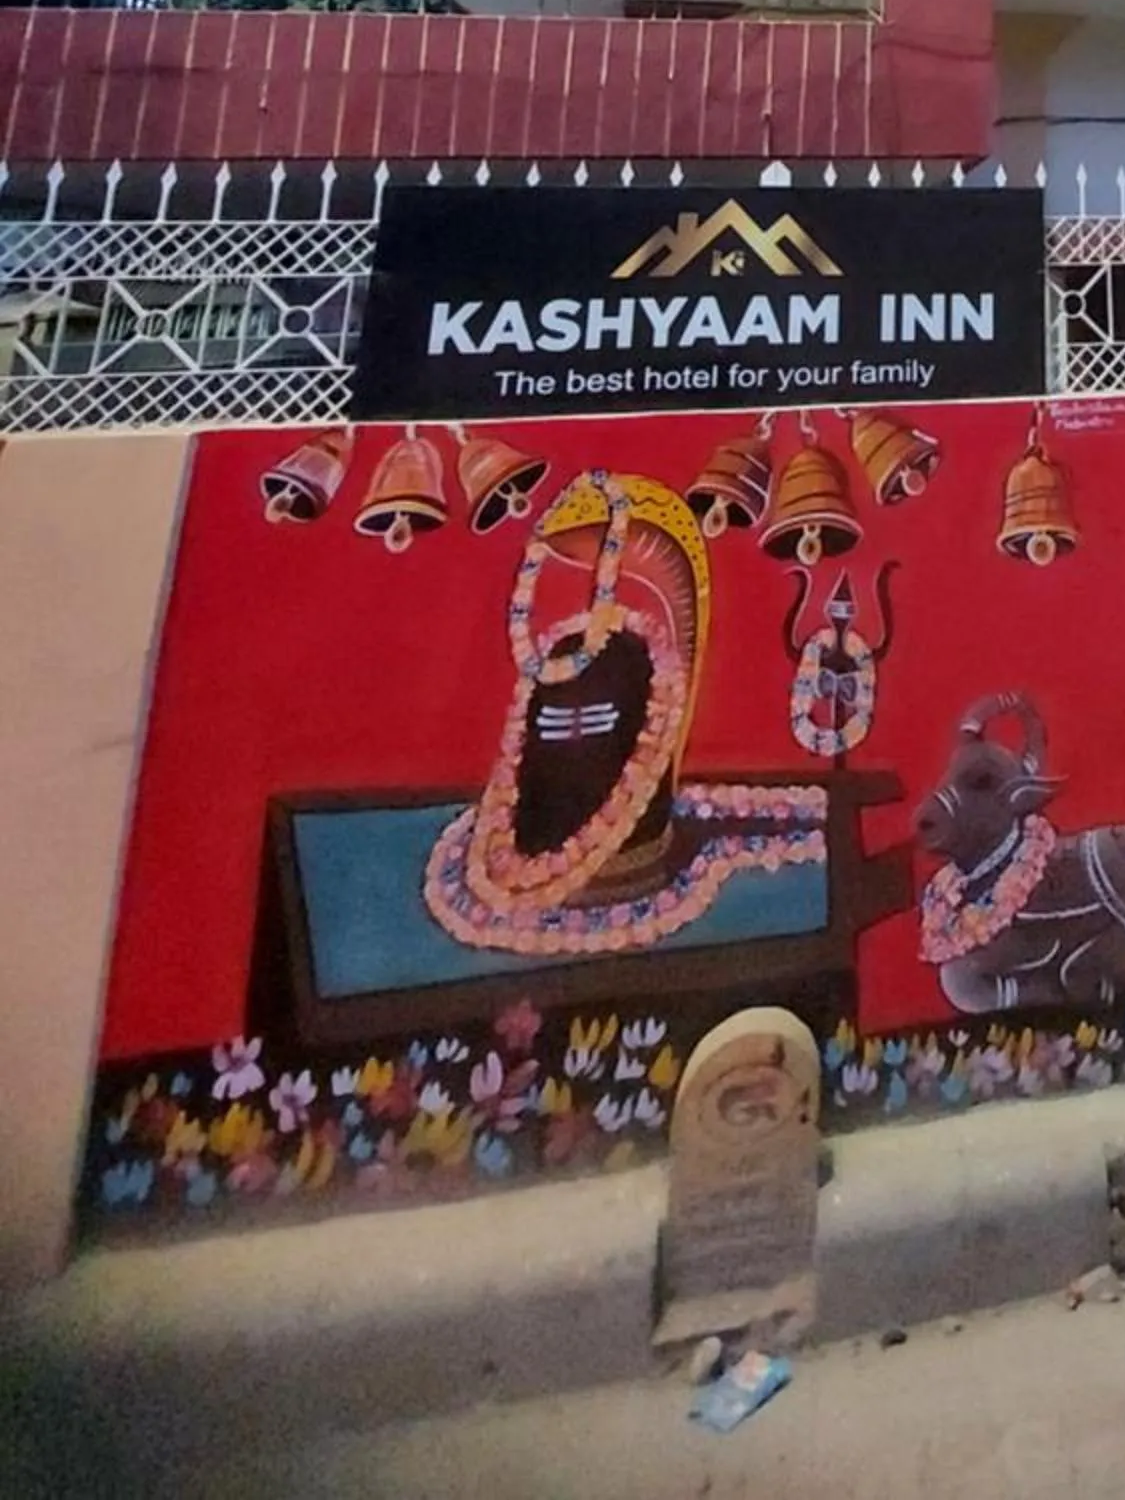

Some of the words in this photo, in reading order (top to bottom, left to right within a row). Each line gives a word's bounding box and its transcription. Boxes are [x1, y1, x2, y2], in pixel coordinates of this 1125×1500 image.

[427, 294, 840, 355] KASHYAAM
[880, 292, 994, 343] INN
[495, 370, 556, 396] The
[566, 368, 634, 394] best
[644, 365, 718, 390] hotel
[728, 363, 769, 387] for
[777, 366, 843, 392] your
[850, 359, 935, 388] family
